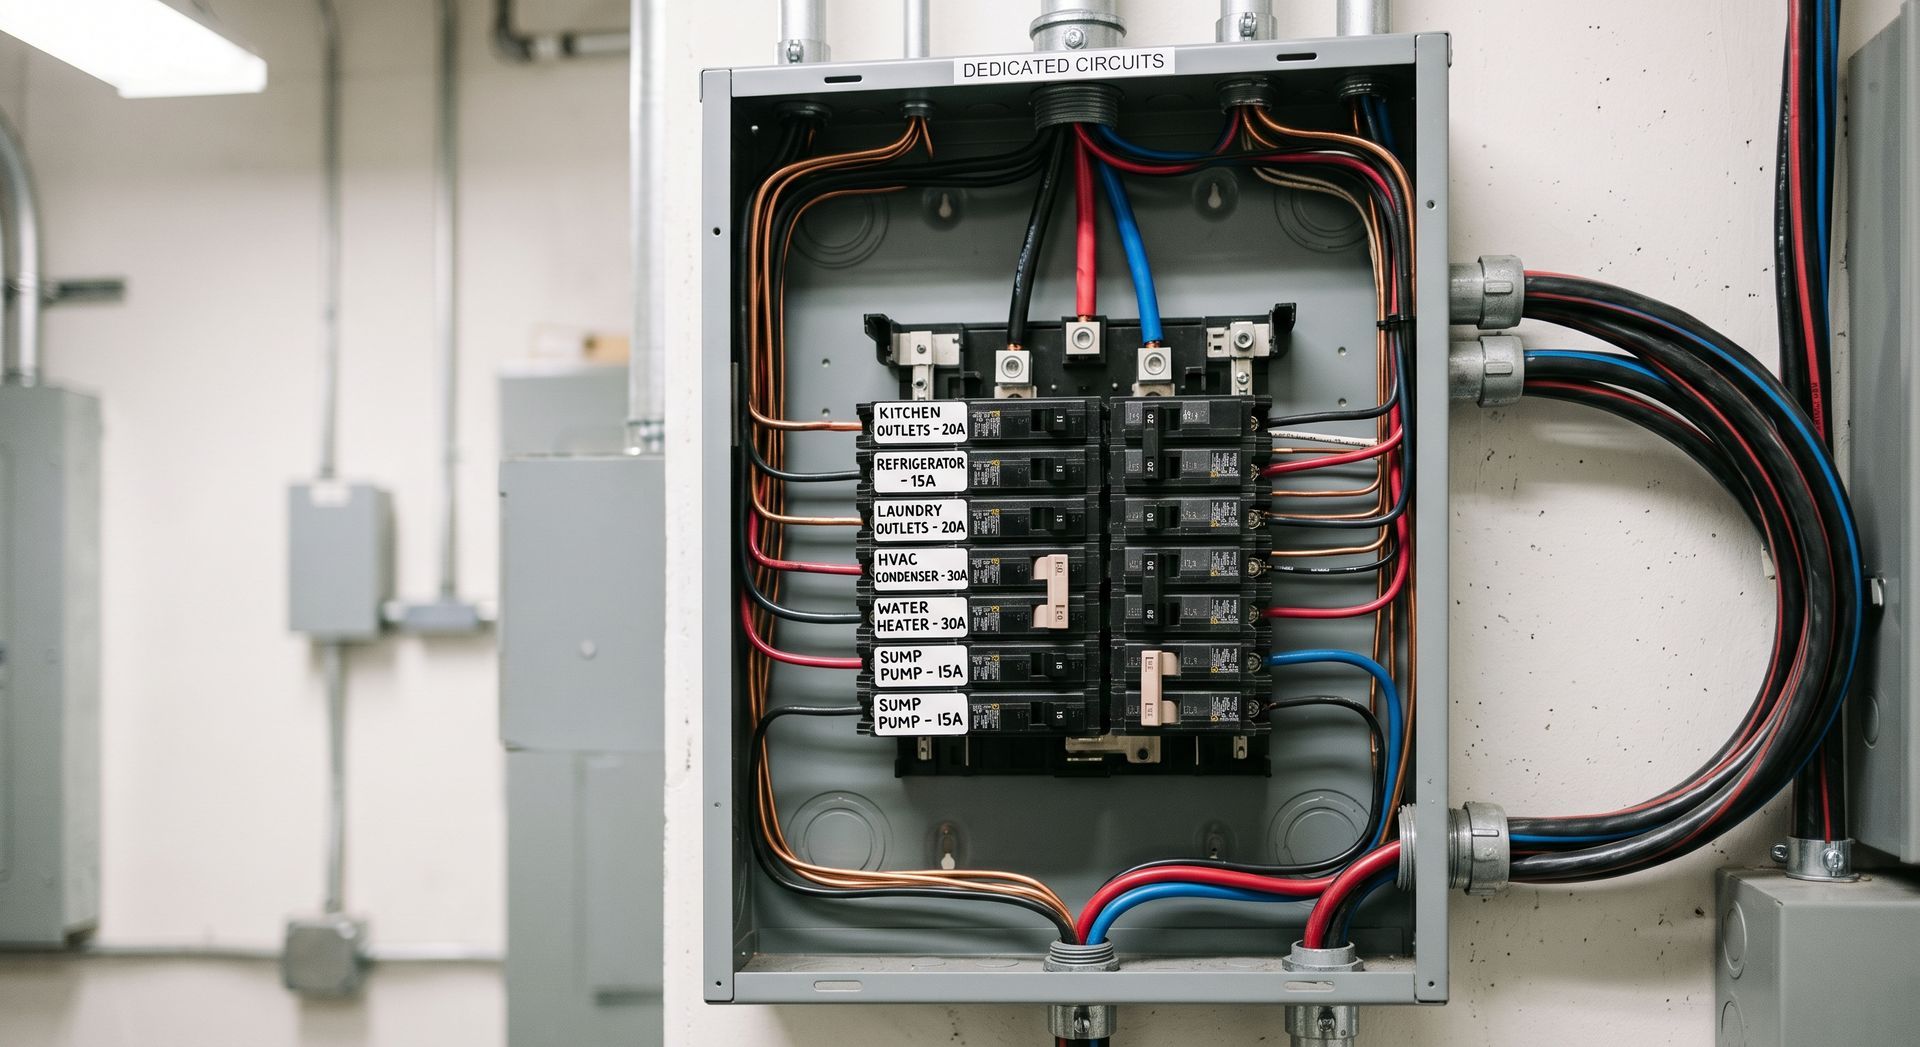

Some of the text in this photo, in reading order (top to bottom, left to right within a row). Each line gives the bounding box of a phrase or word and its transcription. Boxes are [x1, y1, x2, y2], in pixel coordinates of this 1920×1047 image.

[963, 53, 1165, 78] DEDICATED CIRCUITS
[879, 406, 941, 420] KITCHEN
[876, 424, 931, 437] OUTLETS
[941, 423, 966, 436] 20A
[876, 457, 966, 471] REFRIGERATOR
[910, 474, 937, 488] 15A
[877, 504, 943, 518] LAUNDRY
[876, 521, 929, 535] OUTLETS
[941, 520, 966, 534] 20A
[878, 552, 918, 566] HVAC
[875, 570, 939, 583] CONDENSER
[947, 569, 969, 582] 30A
[877, 600, 929, 615] WATER
[877, 617, 930, 632] HEATER
[941, 616, 966, 630] 30A
[880, 649, 922, 664] SUMP
[880, 666, 923, 681] PUMP
[938, 664, 964, 679] 15A
[879, 697, 922, 712] SUMP
[878, 714, 921, 729] PUMP
[937, 712, 963, 727] 15A
